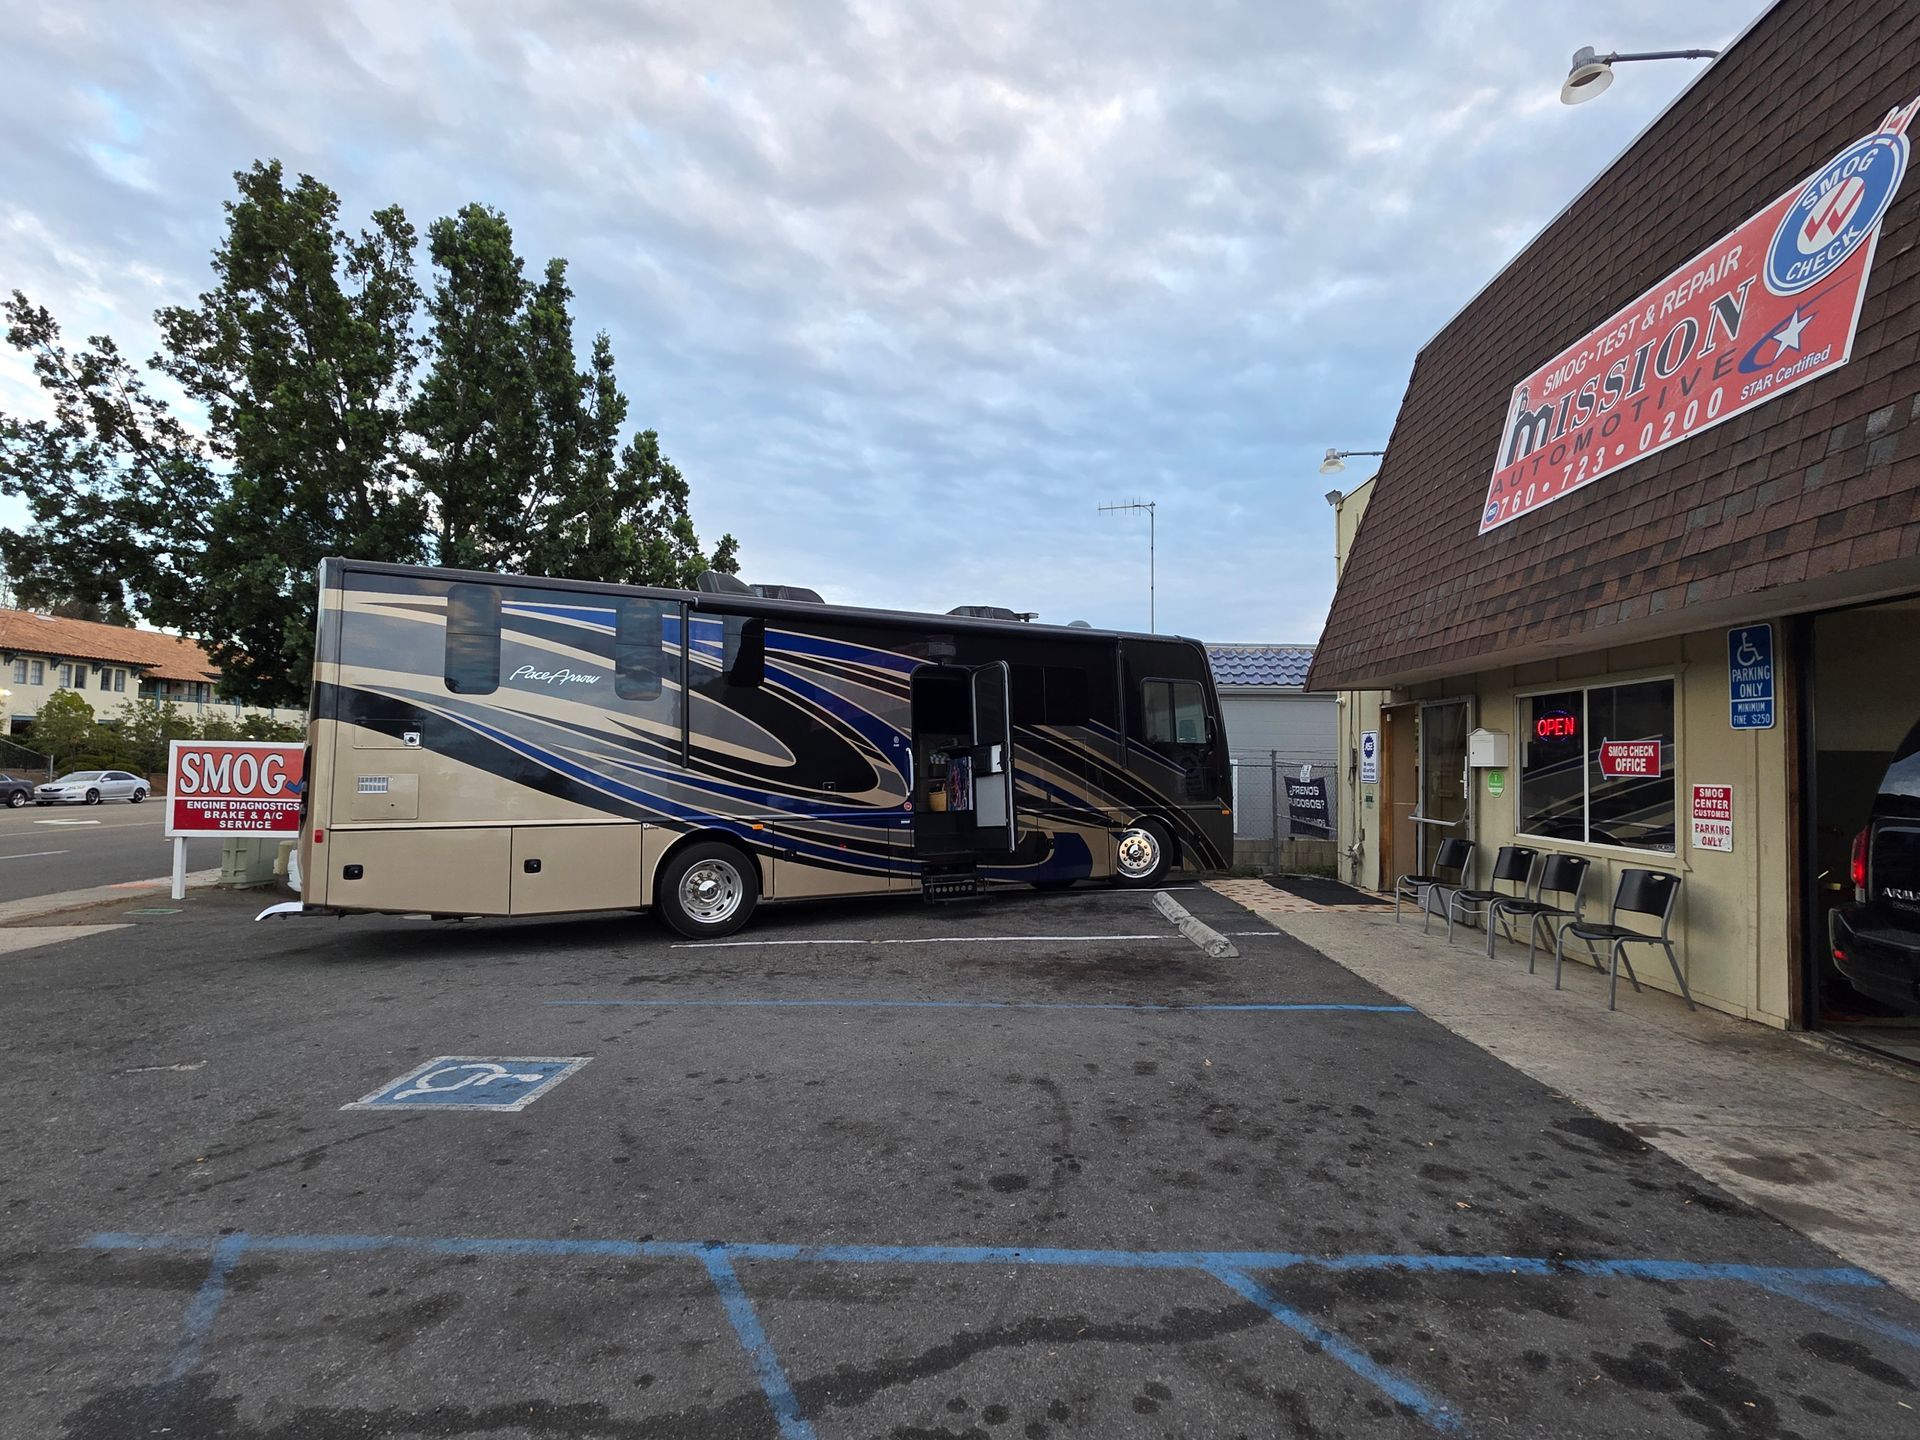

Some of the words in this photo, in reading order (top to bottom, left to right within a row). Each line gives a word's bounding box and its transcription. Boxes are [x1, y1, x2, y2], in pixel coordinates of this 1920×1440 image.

[1802, 148, 1879, 210] SMOG
[1786, 225, 1861, 280] CHECK
[1641, 304, 1655, 331] &
[1660, 245, 1742, 319] REPAIR
[1741, 377, 1772, 400] STAR
[1776, 344, 1831, 383] Certified
[1491, 348, 1736, 497] AUTOMOTIVE
[509, 665, 550, 681] Pace
[547, 669, 601, 685] Arrow
[1732, 665, 1770, 683] PARKING
[1740, 682, 1763, 698] ONLY
[1738, 702, 1765, 713] MINIMUM
[1733, 714, 1747, 725] FINE
[1752, 713, 1770, 725] $250
[1537, 717, 1575, 736] OPEN
[1608, 746, 1628, 757] SMOG
[1629, 745, 1654, 757] CHECK
[1615, 758, 1646, 772] OFFICE
[180, 751, 287, 796] SMOG
[1699, 788, 1724, 798] SMOG
[187, 801, 227, 809] ENGINE
[229, 802, 300, 811] DIAGNOSTICS
[1695, 799, 1729, 810] CENTER
[204, 811, 245, 819] BRAKE
[263, 812, 283, 820] A/C
[1694, 809, 1730, 819] CUSTOMER
[219, 820, 272, 829] SERVICE
[1695, 823, 1730, 836] PARKING
[1702, 836, 1723, 847] ONLY
